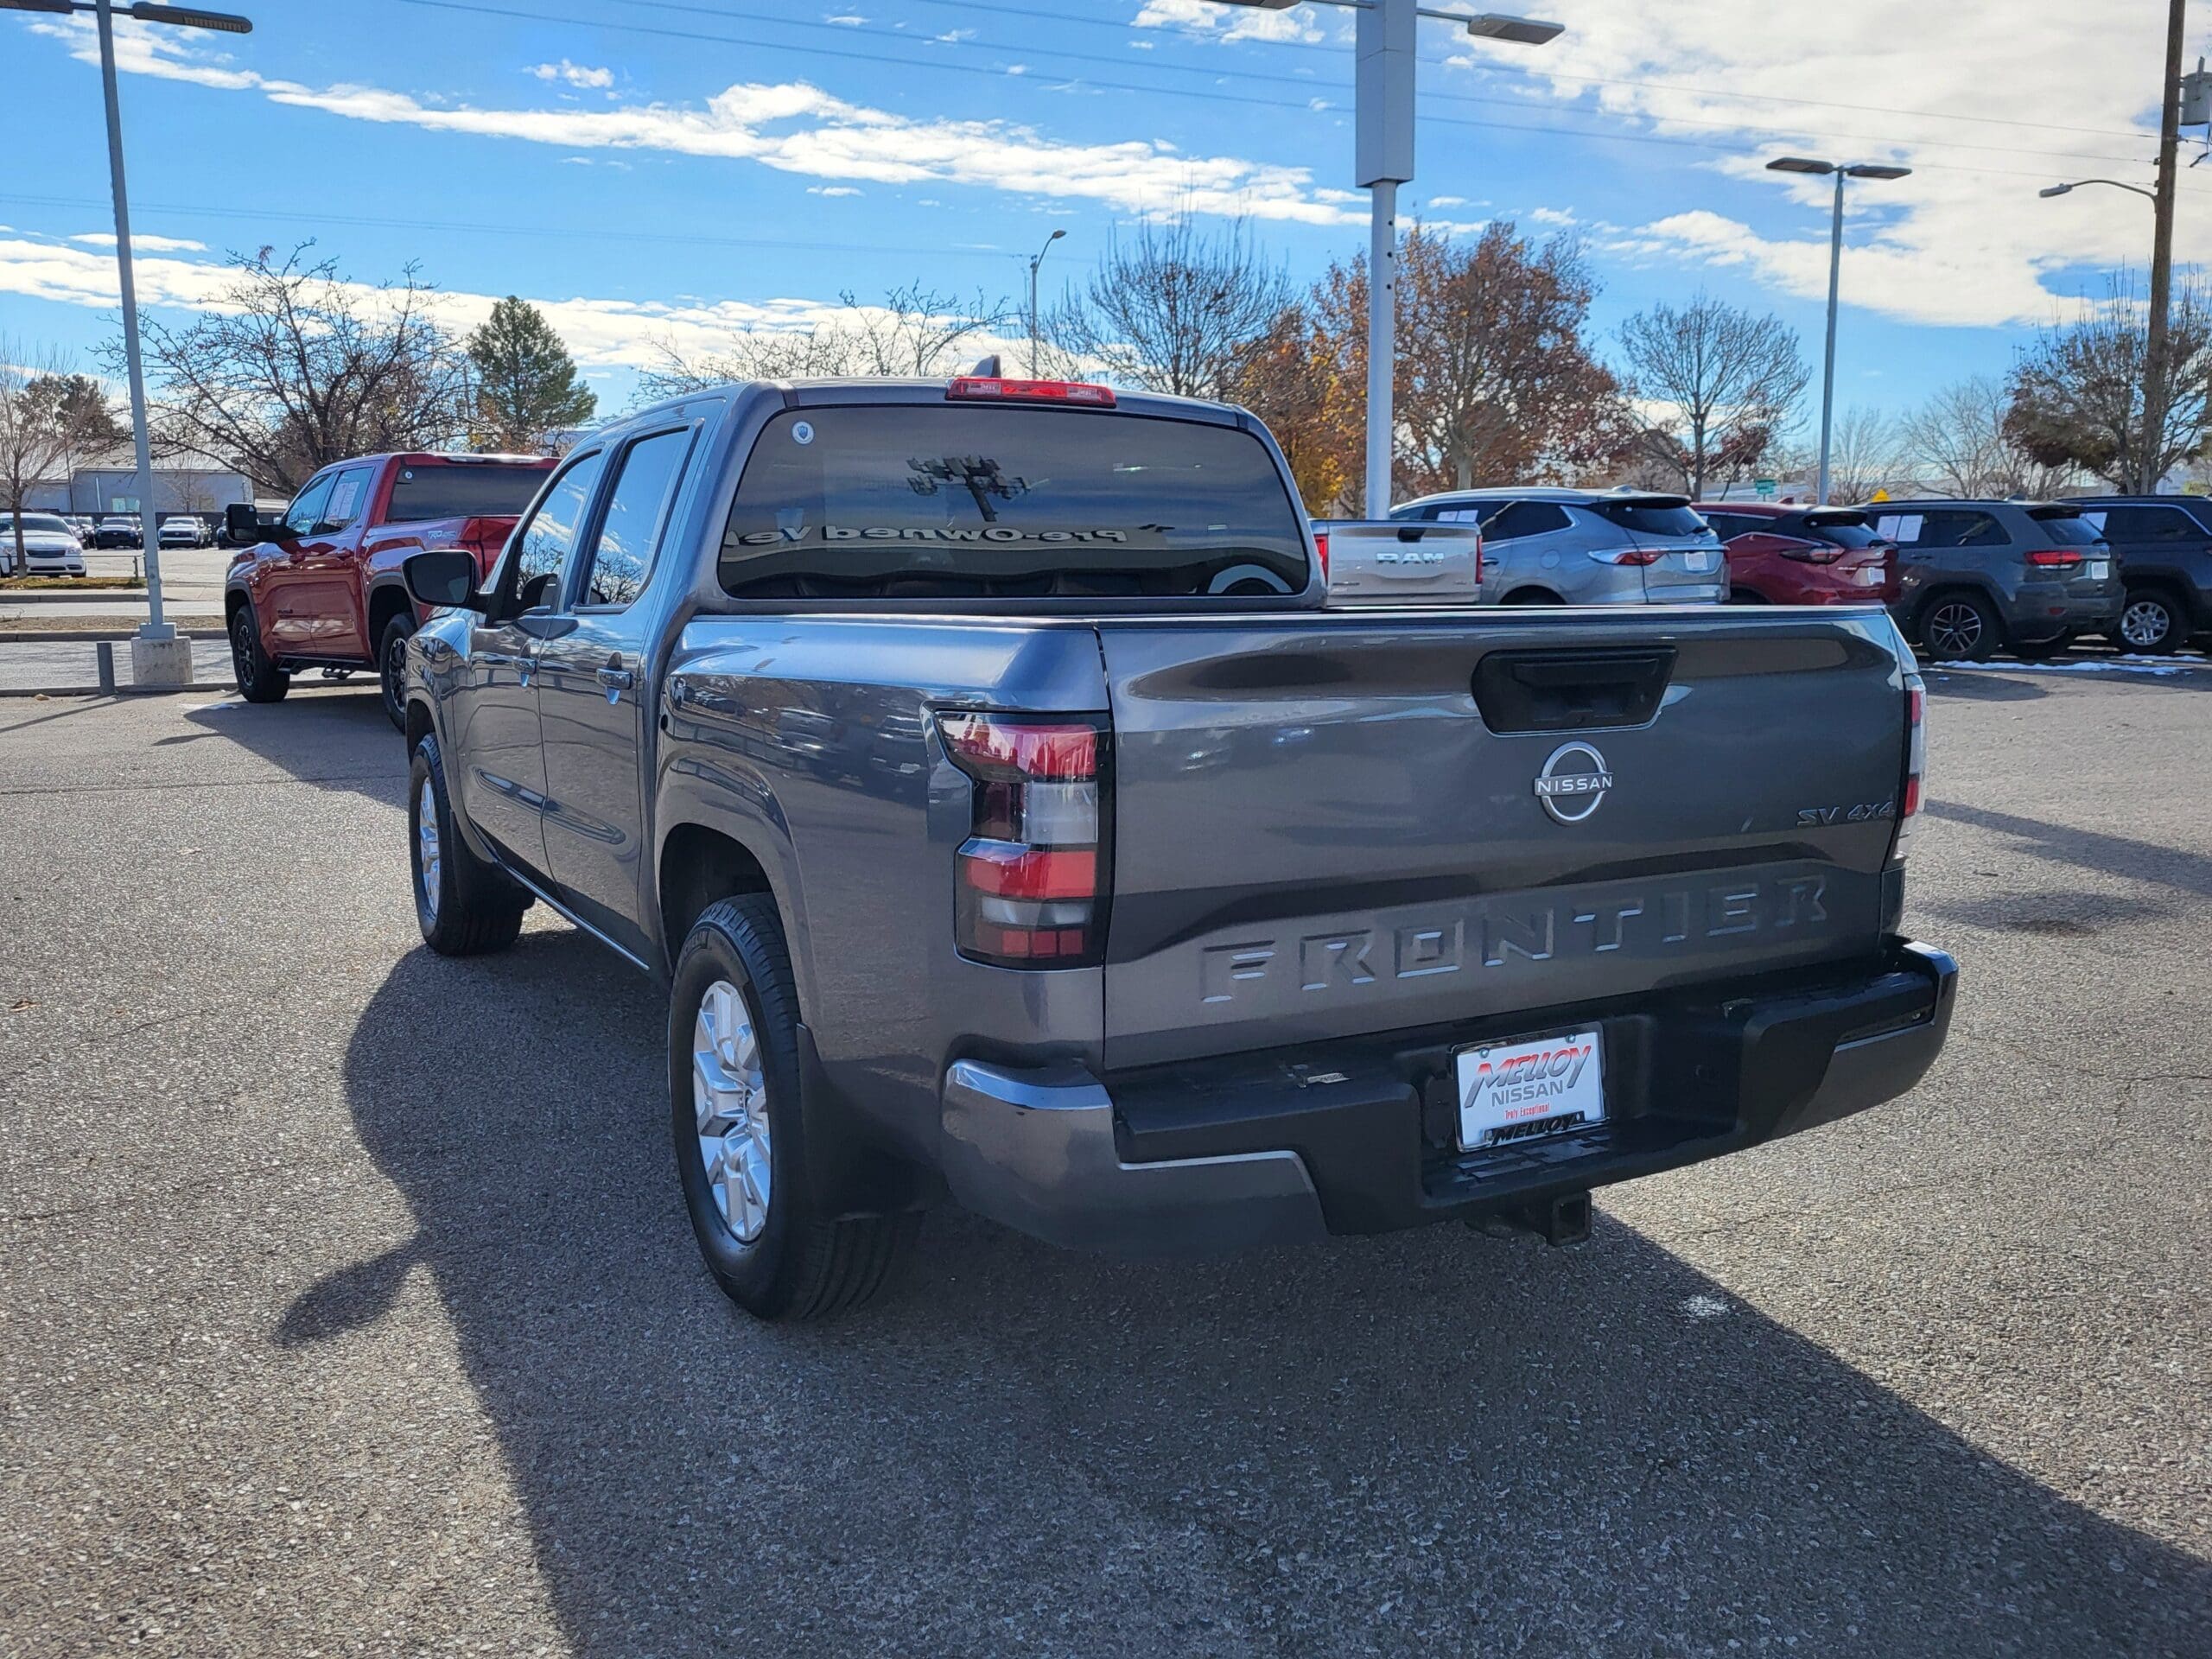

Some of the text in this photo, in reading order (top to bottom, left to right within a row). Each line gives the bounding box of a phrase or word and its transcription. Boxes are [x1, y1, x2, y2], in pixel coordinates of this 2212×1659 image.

[1376, 552, 1445, 564] RAM
[1537, 775, 1613, 793] NISSAN
[1796, 806, 1840, 826] SV
[1202, 875, 1828, 1002] FRONTIER
[1464, 1045, 1592, 1109] MELLOY
[1491, 1079, 1564, 1108] NISSAN
